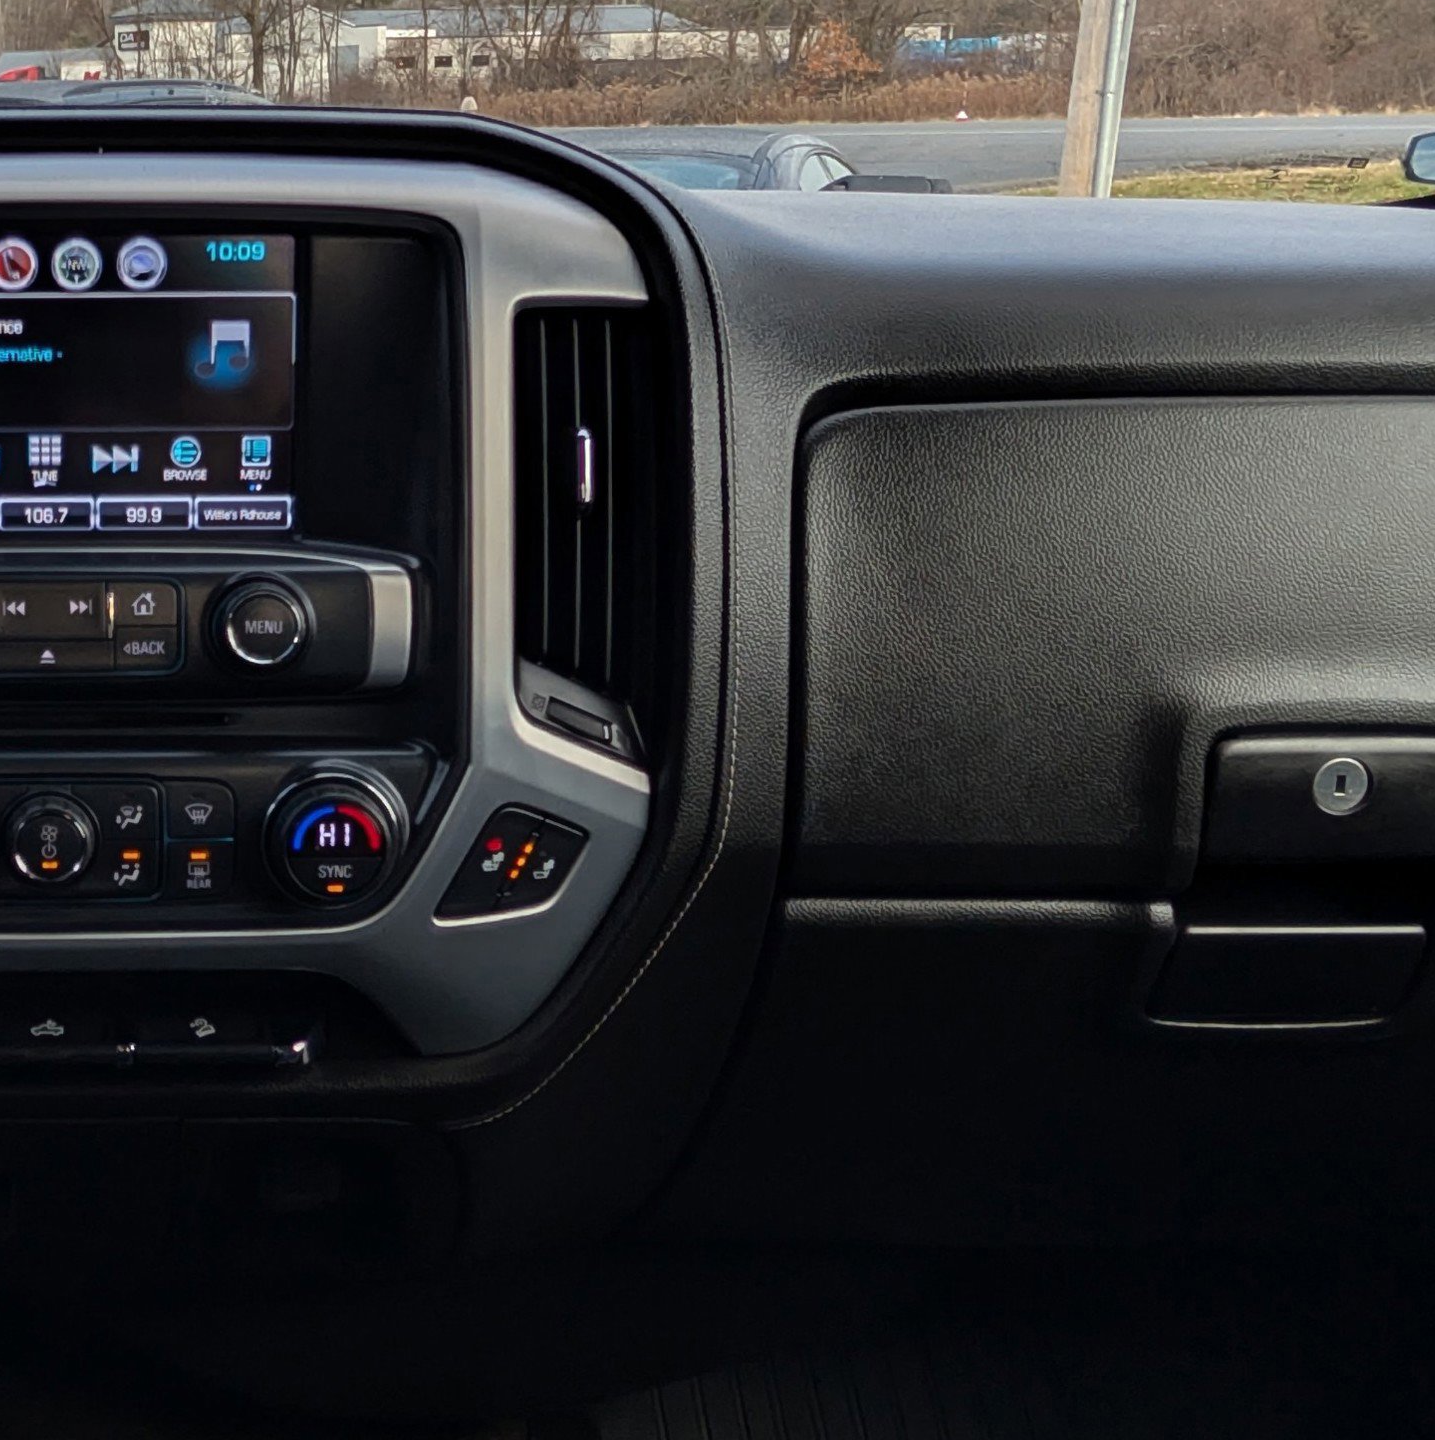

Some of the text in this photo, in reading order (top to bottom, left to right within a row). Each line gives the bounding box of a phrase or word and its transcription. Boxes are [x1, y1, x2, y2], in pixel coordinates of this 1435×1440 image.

[205, 241, 266, 262] 10:09
[30, 470, 59, 483] TUNE
[163, 468, 208, 482] BROWSE
[239, 468, 273, 481] MENU
[24, 507, 70, 525] 106.7
[125, 506, 163, 524] 99.9
[244, 619, 284, 636] MENU
[131, 639, 166, 656] BACK
[318, 822, 352, 848] HI
[317, 863, 353, 880] SYNC
[186, 876, 212, 890] REAR
